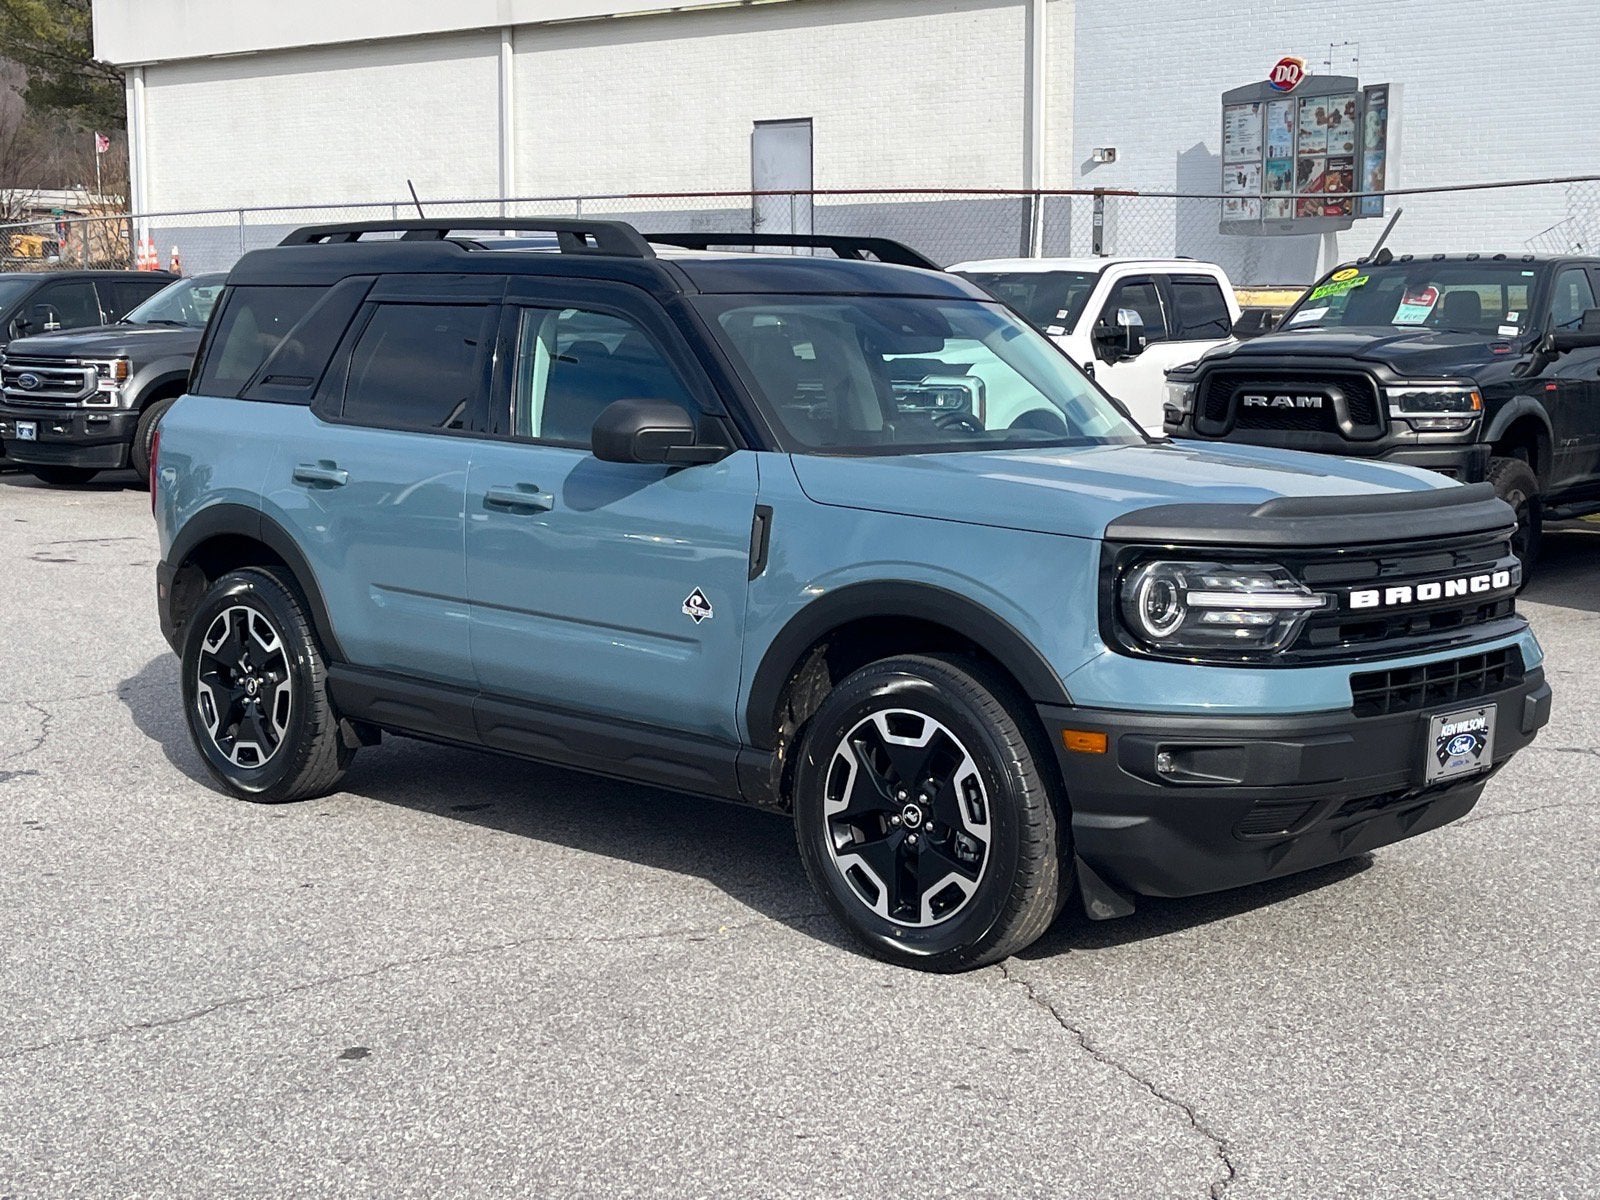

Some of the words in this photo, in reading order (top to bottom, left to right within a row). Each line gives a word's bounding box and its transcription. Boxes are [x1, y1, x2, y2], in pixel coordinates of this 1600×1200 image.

[1274, 64, 1299, 84] DQ
[1243, 395, 1323, 408] RAM
[1349, 571, 1510, 609] BRONCO
[1441, 722, 1458, 737] KEN
[1457, 717, 1486, 733] WILSON
[1451, 737, 1471, 753] Ford
